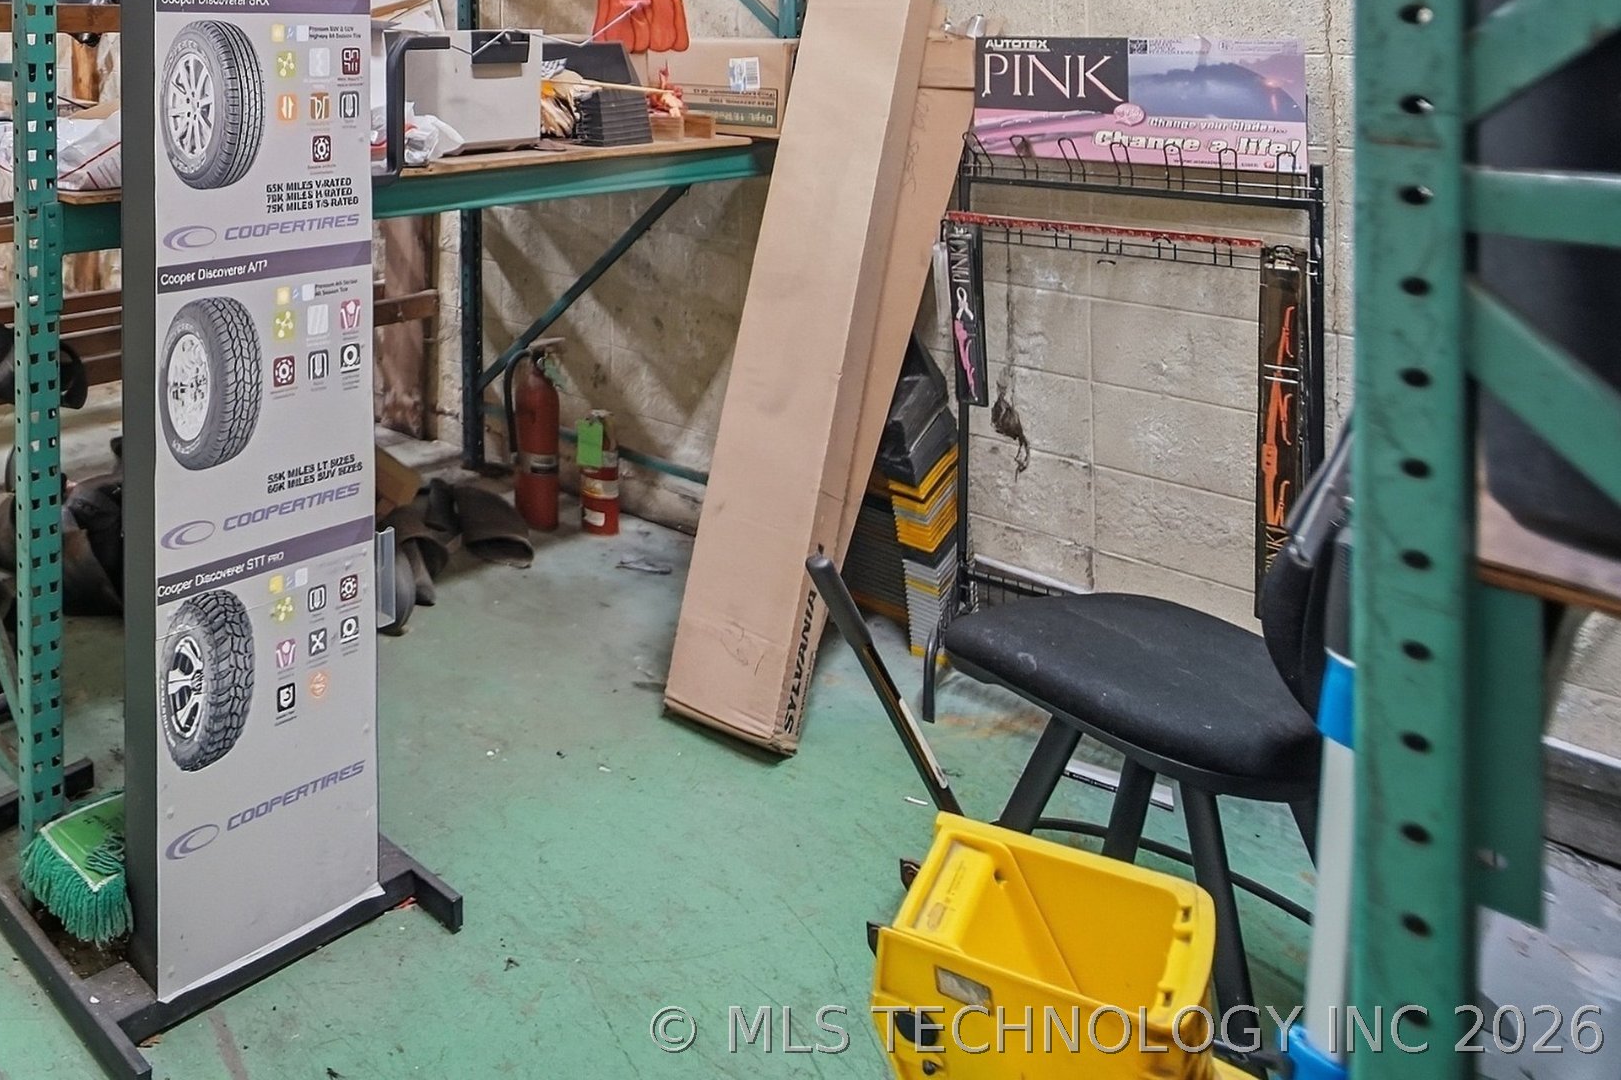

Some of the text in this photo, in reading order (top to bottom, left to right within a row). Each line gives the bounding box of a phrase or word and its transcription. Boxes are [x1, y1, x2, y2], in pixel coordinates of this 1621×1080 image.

[985, 39, 1048, 50] AUTOTEX
[981, 53, 1124, 102] PINK
[1094, 129, 1301, 158] Change a life!
[266, 183, 284, 193] 65K
[286, 180, 313, 191] MILES
[286, 191, 313, 201] MILES
[266, 203, 284, 213] 75K
[286, 201, 313, 211] MILES
[160, 270, 196, 286] Cooper
[198, 263, 246, 281] Discoverer
[288, 464, 315, 479] MILES
[317, 460, 328, 471] LT
[288, 474, 315, 489] MILES
[157, 579, 193, 597] Cooper
[195, 563, 245, 587] Discoverer
[247, 554, 266, 570] STT
[784, 590, 816, 735] SYLVANIA
